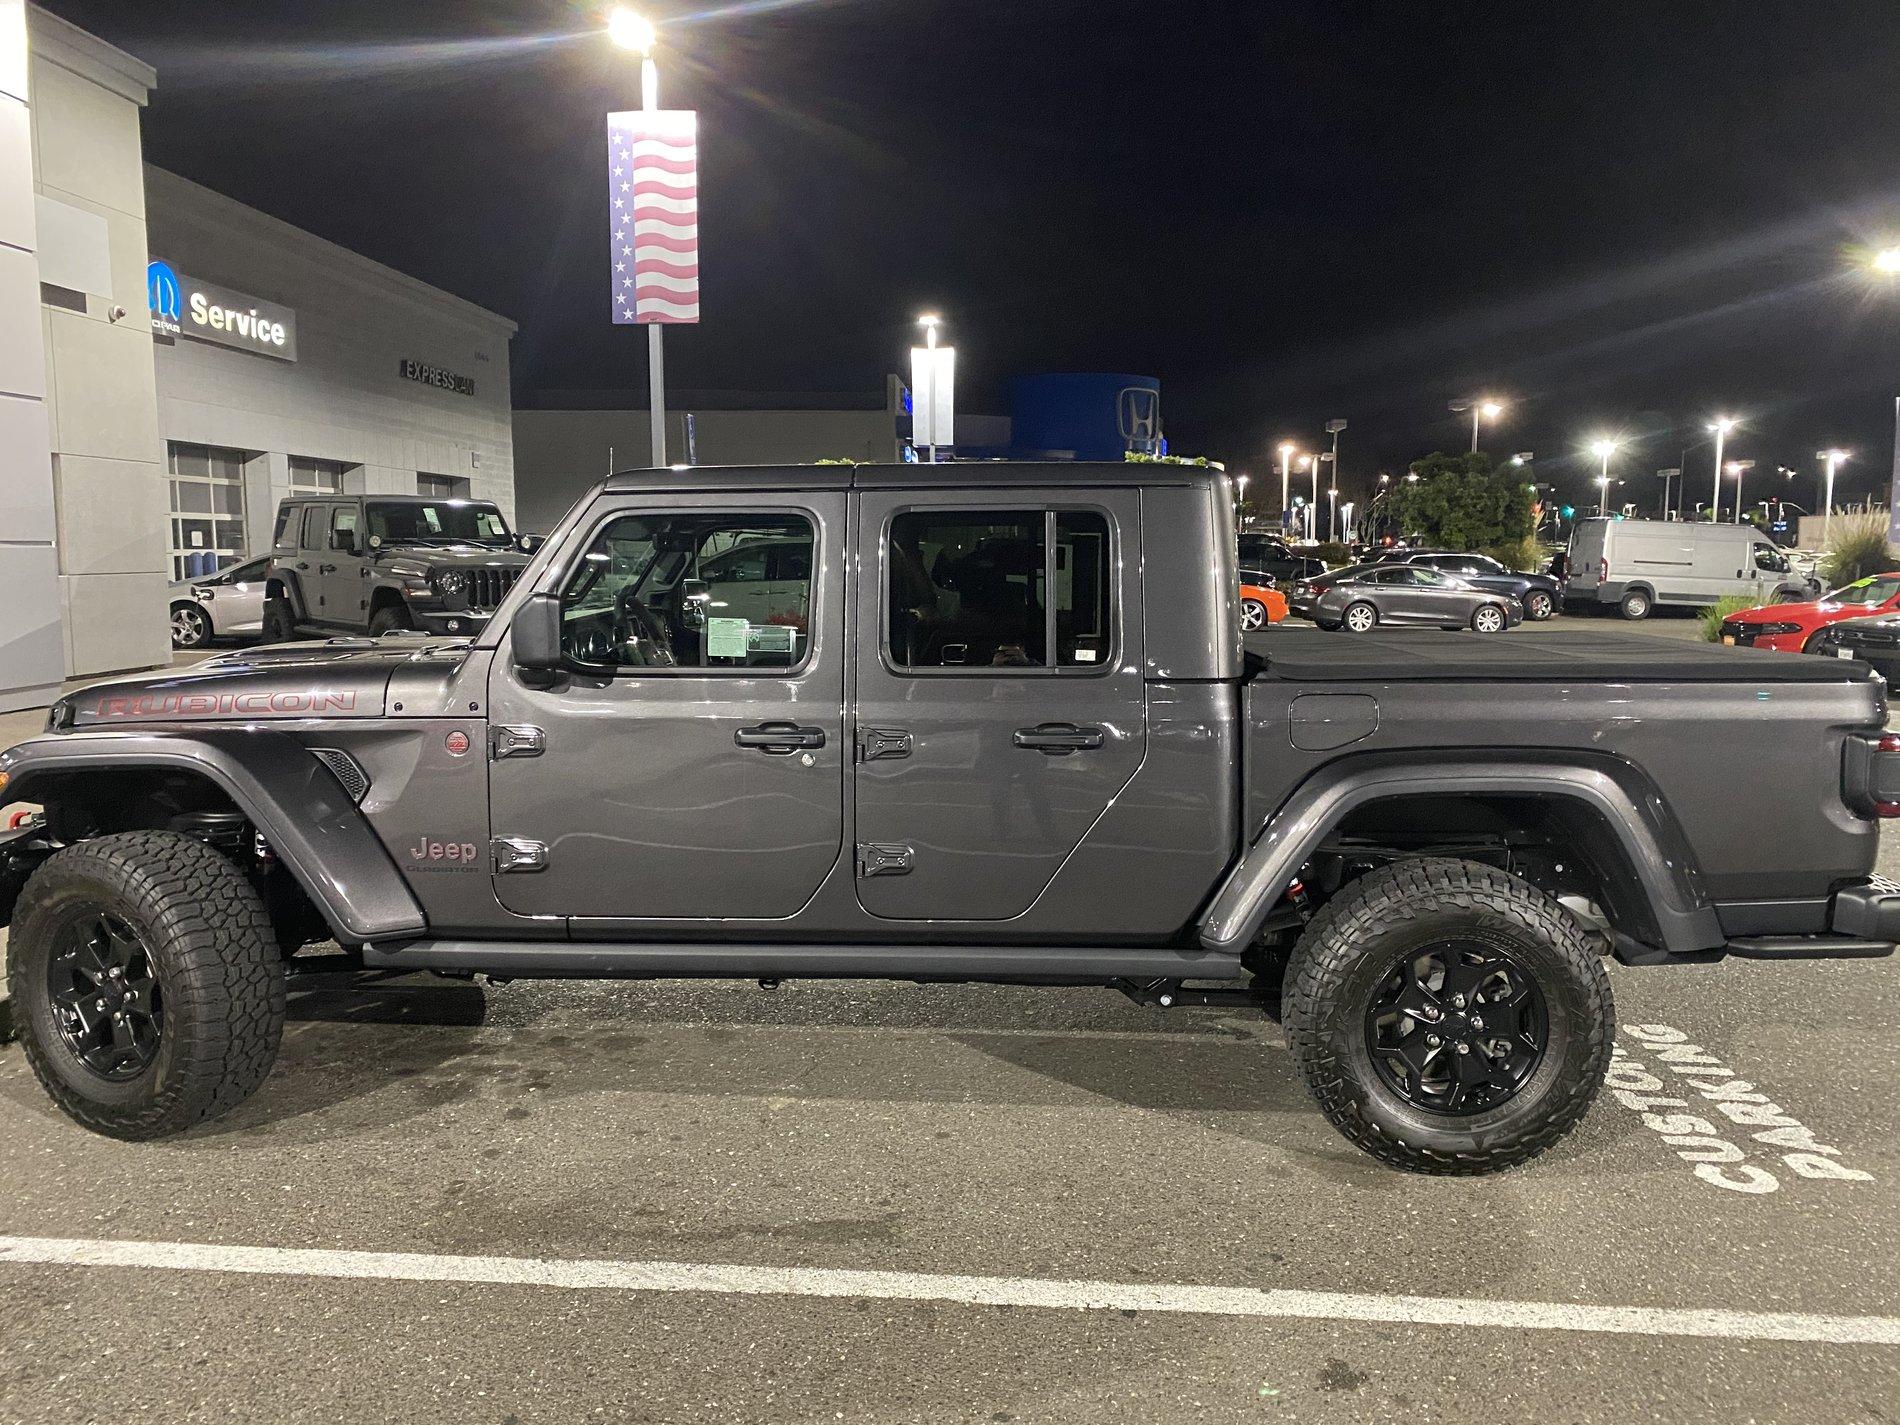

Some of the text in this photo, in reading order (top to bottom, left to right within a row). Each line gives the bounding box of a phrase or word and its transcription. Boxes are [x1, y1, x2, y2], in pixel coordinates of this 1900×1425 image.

[151, 319, 181, 334] OPAR
[190, 292, 286, 346] Service
[95, 689, 357, 719] RUBICON
[410, 836, 478, 864] Jeep
[1622, 1023, 1876, 1182] PARKING
